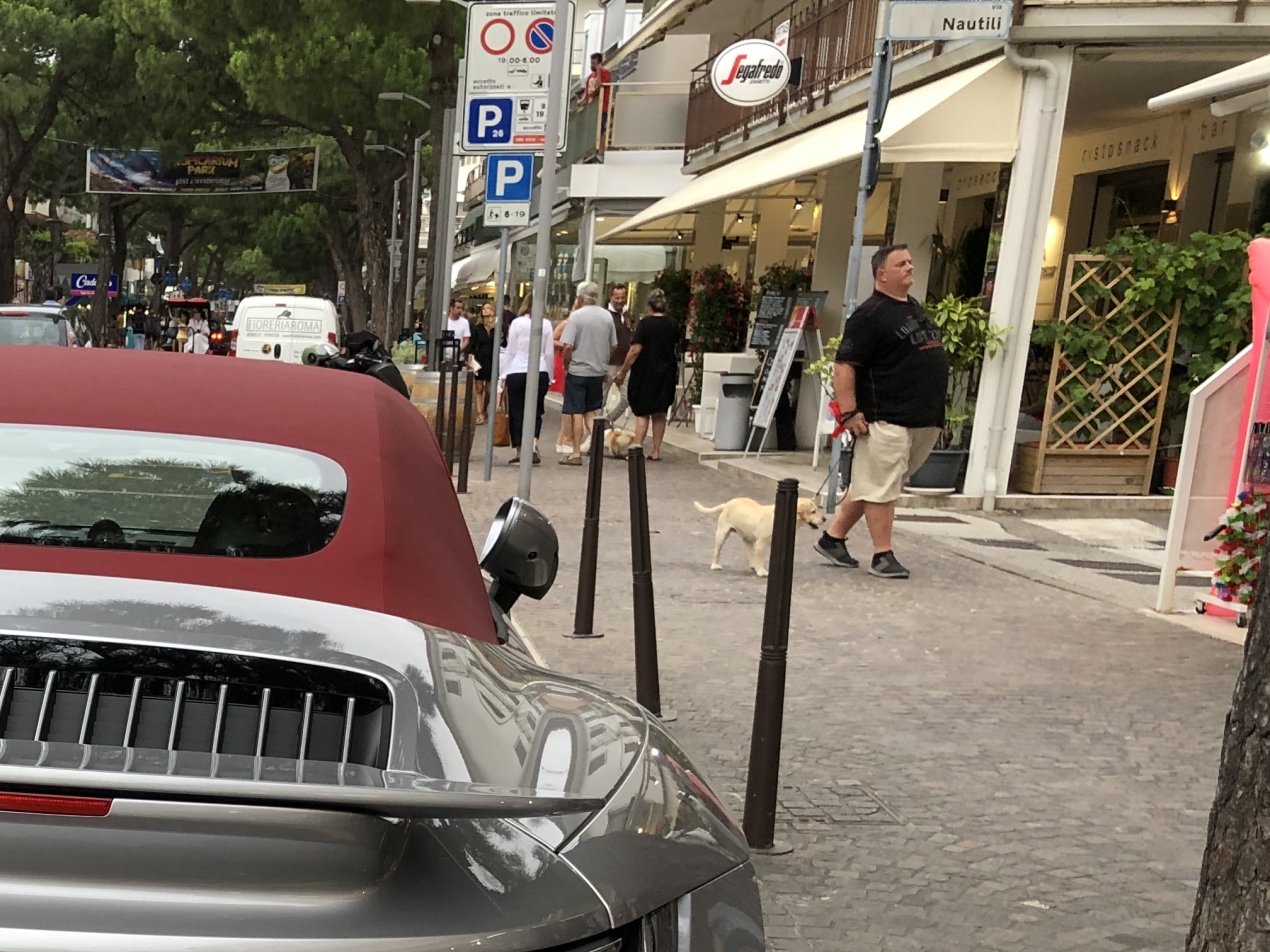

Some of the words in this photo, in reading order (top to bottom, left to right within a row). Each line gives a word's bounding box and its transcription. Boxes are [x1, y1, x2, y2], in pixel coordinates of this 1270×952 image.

[942, 17, 1002, 31] Nautili
[720, 54, 784, 86] Segafredo
[477, 104, 503, 138] P
[1200, 119, 1228, 141] bar
[187, 166, 217, 176] PARK
[495, 160, 524, 197] P
